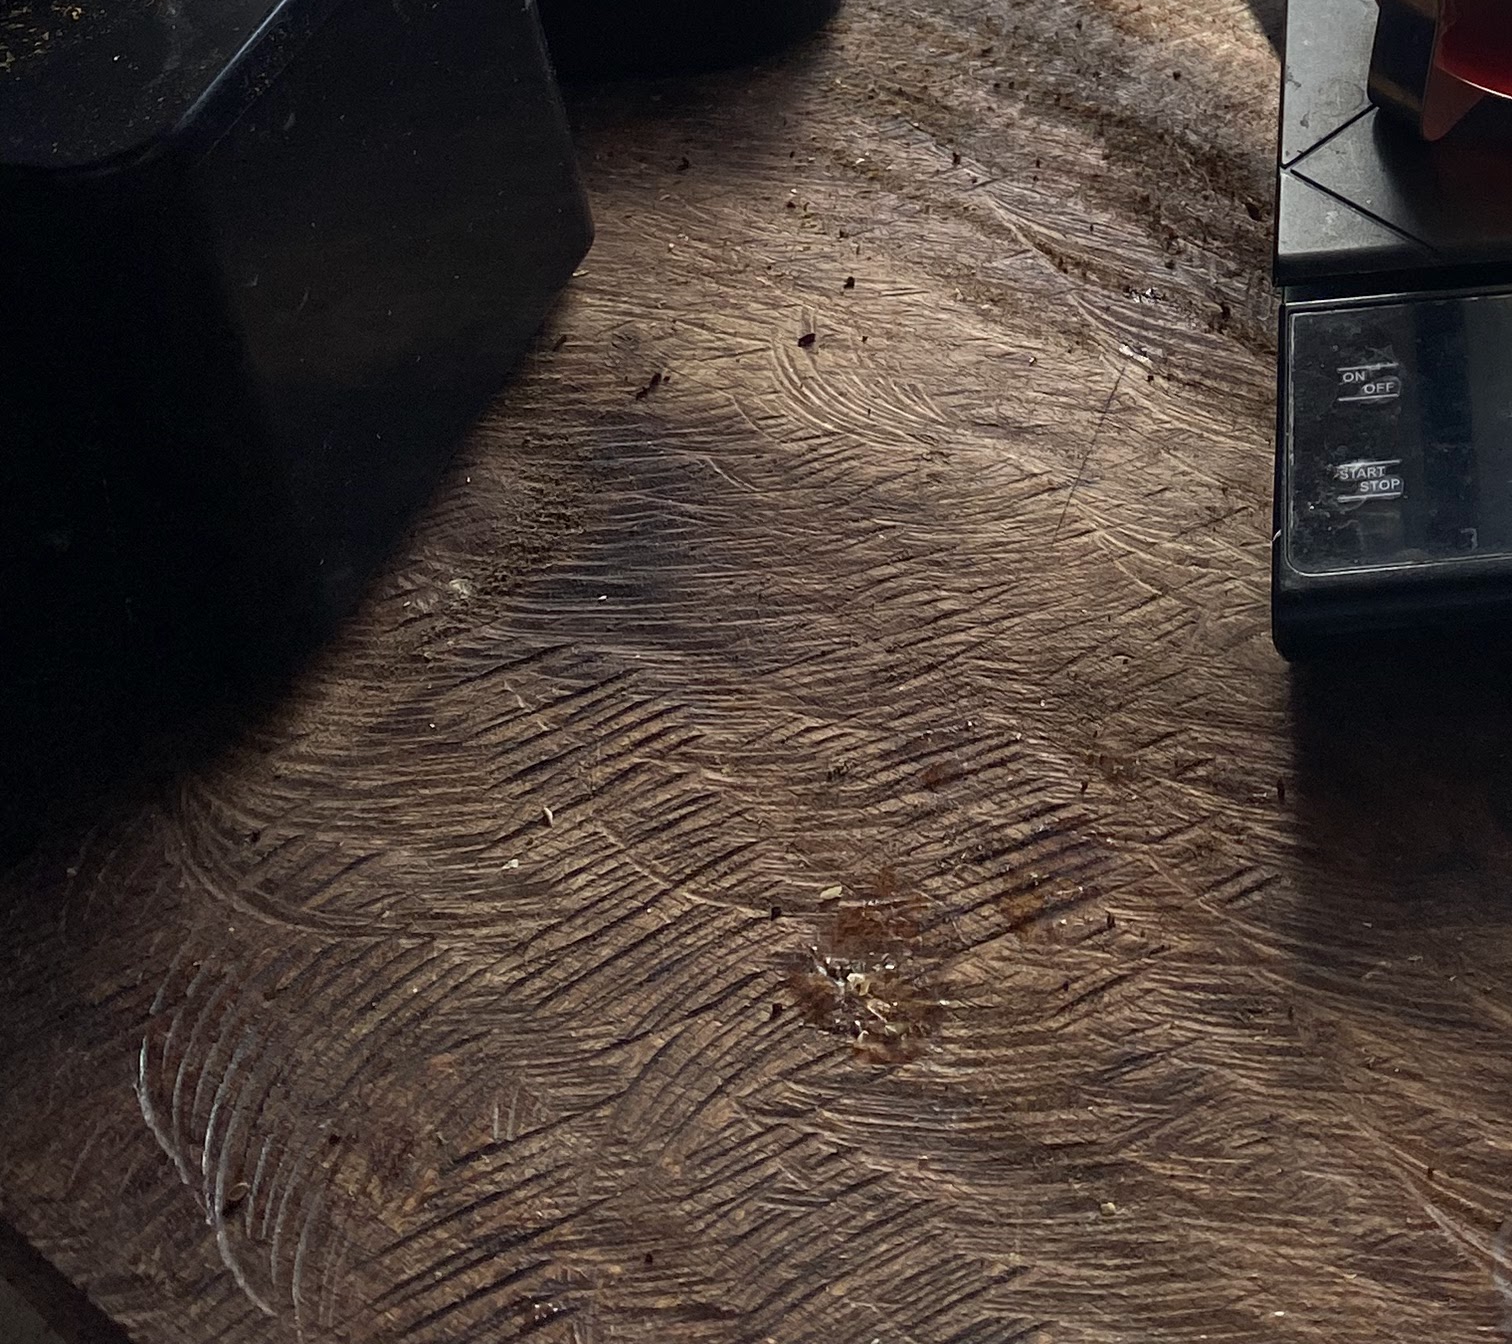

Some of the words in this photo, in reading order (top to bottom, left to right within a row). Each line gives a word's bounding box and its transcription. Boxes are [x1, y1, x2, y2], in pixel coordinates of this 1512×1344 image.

[1342, 370, 1366, 383] ON
[1363, 381, 1395, 394] OFF
[1339, 465, 1386, 480] START
[1360, 478, 1401, 492] STOP
